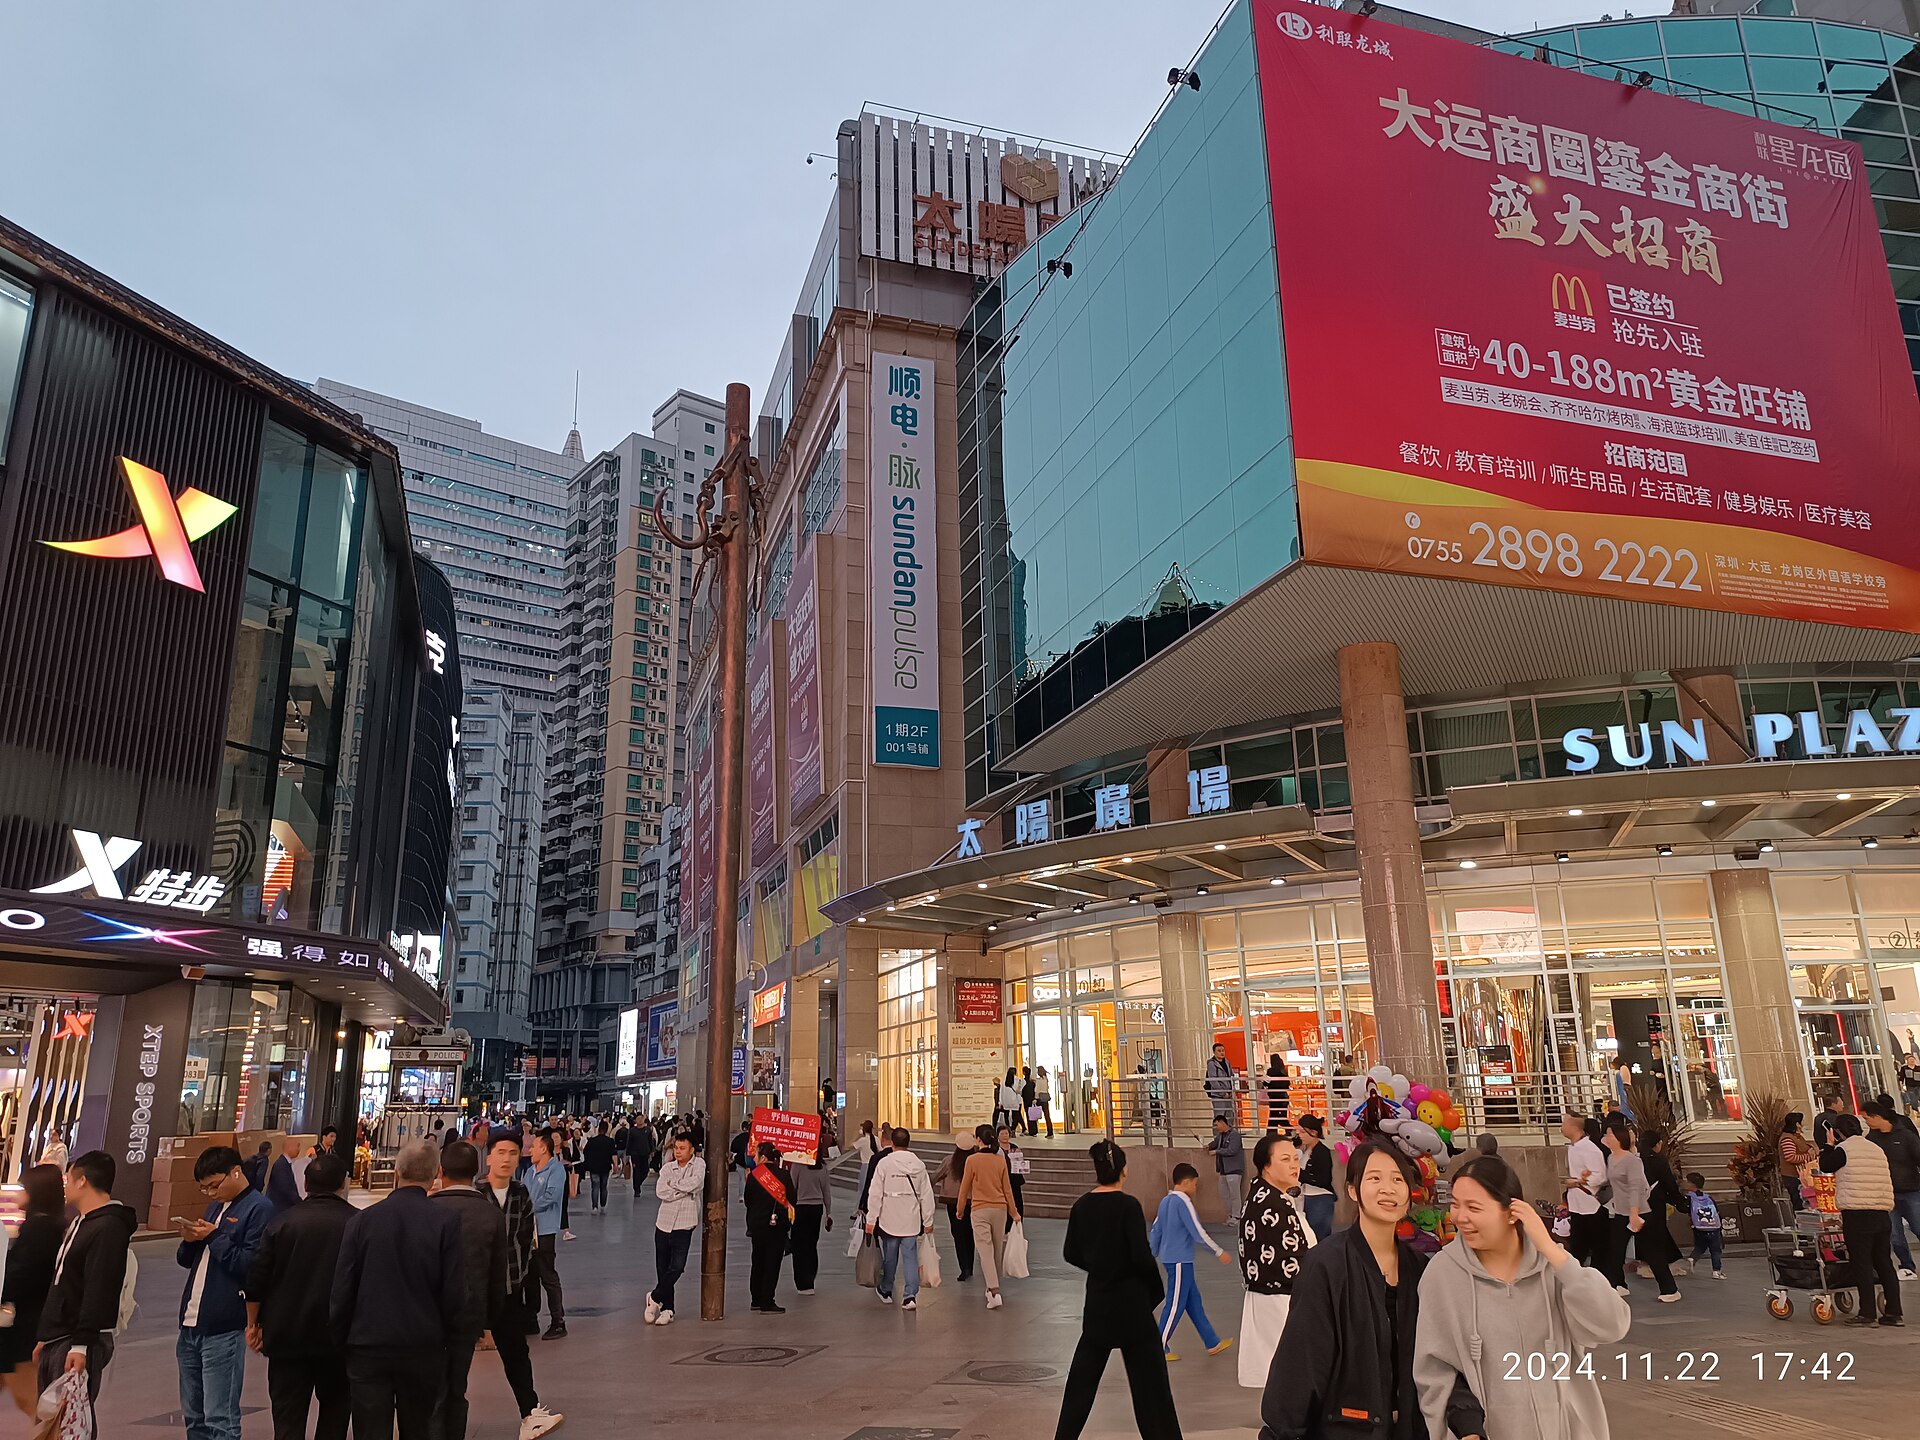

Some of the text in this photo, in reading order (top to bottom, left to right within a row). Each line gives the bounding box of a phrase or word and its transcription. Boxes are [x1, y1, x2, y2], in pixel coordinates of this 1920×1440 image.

[1314, 24, 1394, 61] 利联龙城
[1379, 87, 1789, 230] 大运商圈鎏金商街
[1488, 175, 1723, 286] 盛大招商
[1606, 283, 1675, 320] 已签约
[1440, 332, 1466, 350] 建筑
[1553, 311, 1596, 333] 麦当劳
[1611, 318, 1705, 358] 抢先入驻
[1442, 349, 1468, 366] 面积
[1604, 441, 1688, 477] 招商范围
[1399, 441, 1873, 532] 餐饮 教育培训 师生用品 生活配套 健身娱乐 医疗美容
[1407, 536, 1464, 564] 0755
[1467, 520, 1585, 579] 2898
[1594, 537, 1703, 593] 2222
[885, 741, 930, 756] 001号铺
[1561, 718, 1710, 773] SUN
[957, 765, 1231, 859] 太陽廣場
[128, 868, 227, 912] 特步
[433, 1051, 460, 1059] POLICE
[126, 1024, 165, 1166] XTEP SPORTS
